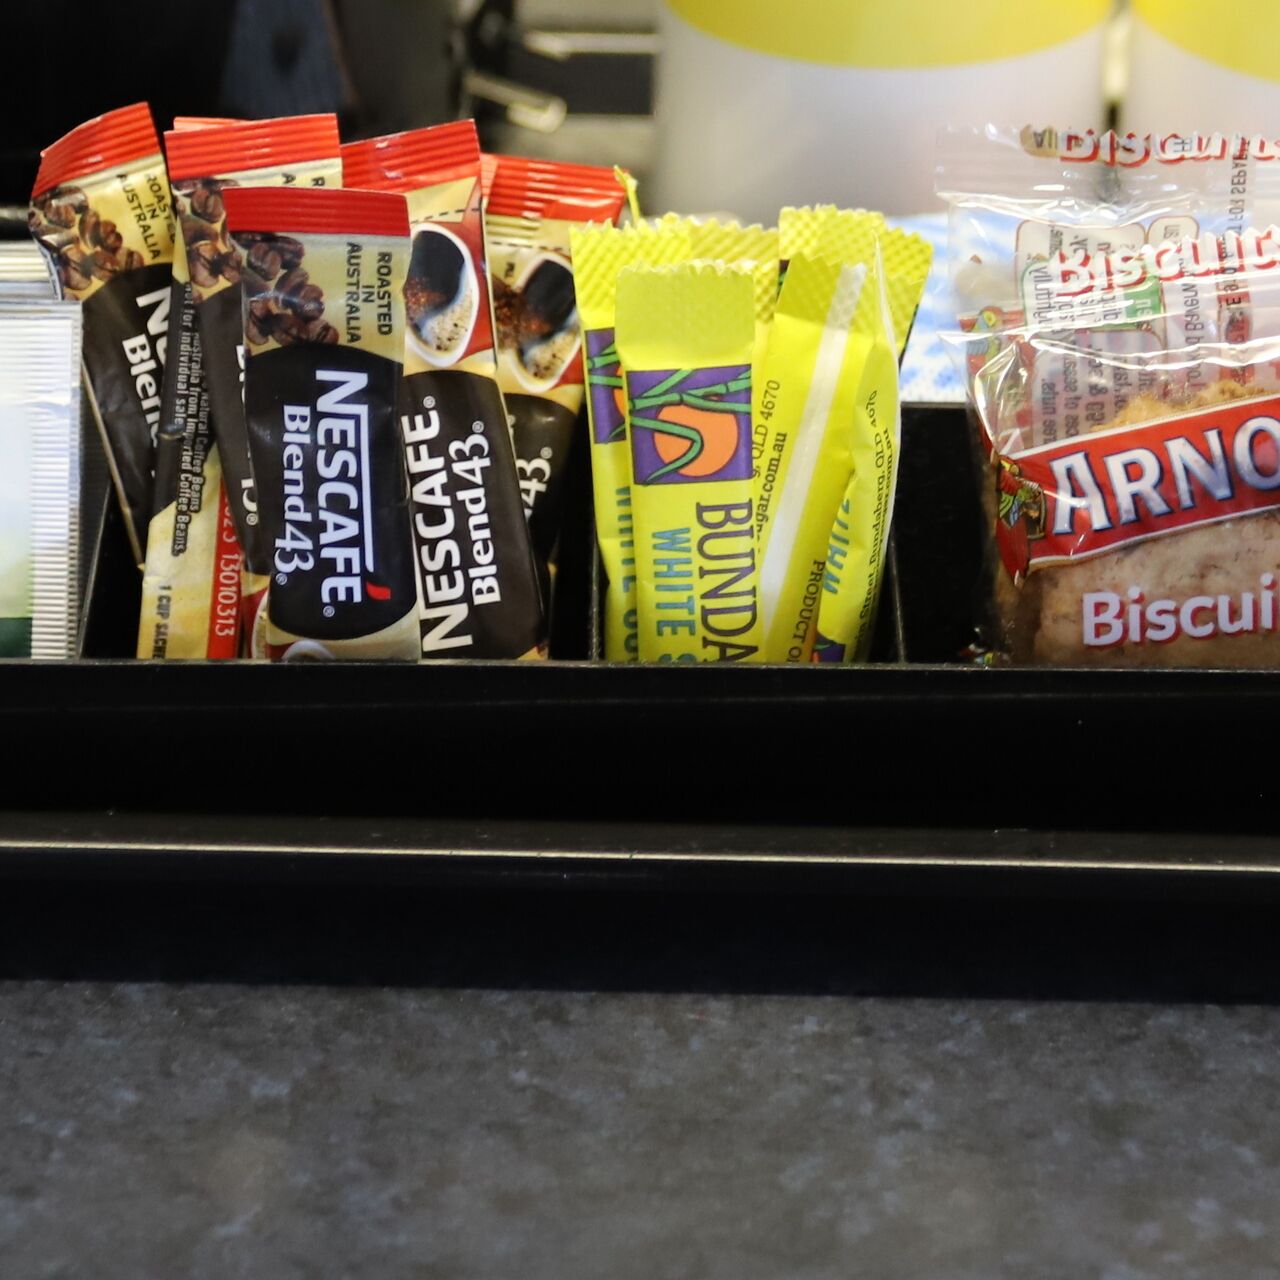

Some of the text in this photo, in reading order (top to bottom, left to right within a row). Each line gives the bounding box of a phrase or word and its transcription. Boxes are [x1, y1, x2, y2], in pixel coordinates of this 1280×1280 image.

[145, 203, 160, 221] IN
[346, 241, 360, 345] AUSTRALIA
[361, 284, 374, 304] IN
[376, 251, 393, 336] ROASTED
[176, 331, 193, 395] individual
[121, 333, 161, 447] Blen
[187, 386, 200, 415] from
[759, 379, 781, 421] 4670
[191, 436, 207, 474] Coffee
[177, 472, 193, 513] Coffee
[188, 475, 204, 512] Beans
[214, 552, 240, 638] 13010313
[651, 527, 696, 637] WHITE
[792, 559, 826, 644] PRODUCT
[156, 595, 171, 619] CUP
